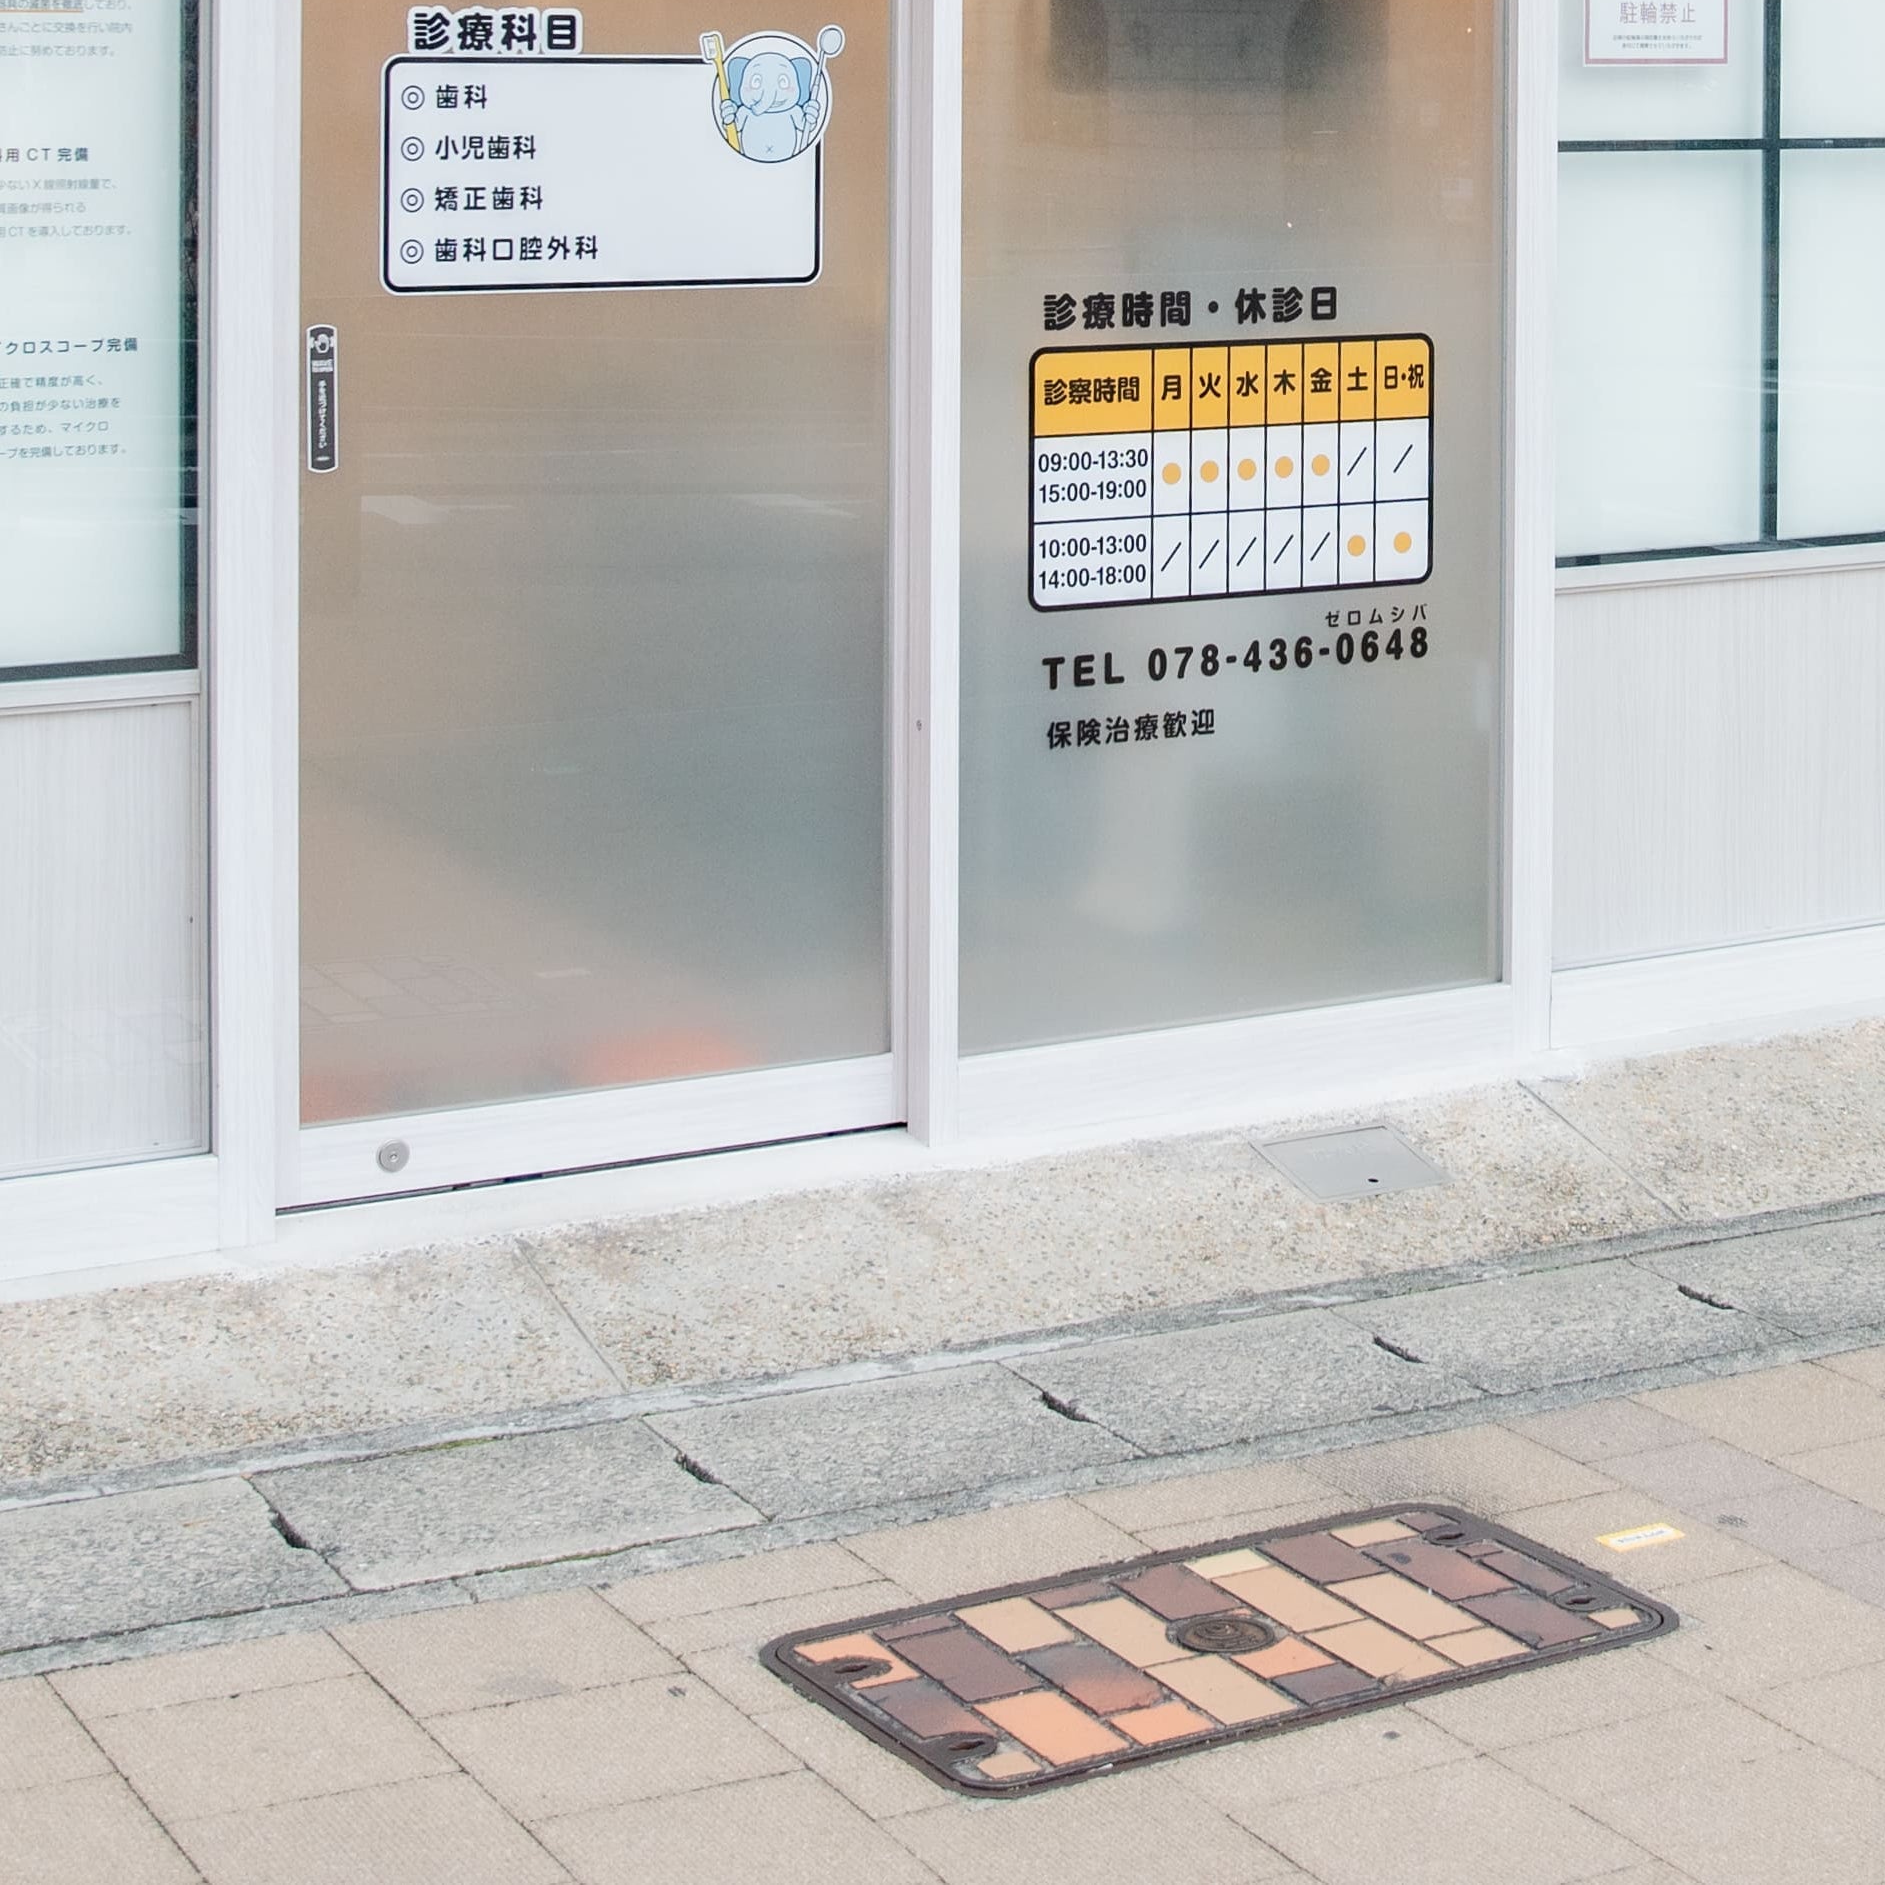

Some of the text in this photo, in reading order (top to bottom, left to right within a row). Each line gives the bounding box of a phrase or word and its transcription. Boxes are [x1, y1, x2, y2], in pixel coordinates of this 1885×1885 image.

[1619, 2, 1696, 24] 駐輪禁止
[413, 12, 577, 52] 診療科目
[435, 84, 488, 110] 歯科
[435, 135, 537, 162] 小児歯科
[434, 185, 544, 212] 矯正歯科
[434, 235, 599, 263] 歯科口腔外科
[1043, 285, 1338, 332] 診療時間・休診日
[0, 337, 138, 355] クロスコープ完備
[1043, 375, 1140, 406] 診察時間
[1160, 374, 1182, 401] 月
[1198, 371, 1222, 399] 火
[1236, 370, 1259, 397] 水
[1273, 368, 1296, 395] 木
[1309, 367, 1333, 393] 金
[1346, 366, 1369, 392] 土
[1038, 448, 1149, 474] 09:00-13:30
[1038, 479, 1147, 504] 15:00-19:00
[1038, 533, 1147, 559] 10:00-13:00
[1038, 564, 1147, 590] 14:00-18:00
[1325, 603, 1428, 628] ゼロムシバ
[1042, 626, 1429, 690] TEL 078-436-0648
[1047, 708, 1216, 750] 保険治療歓迎
